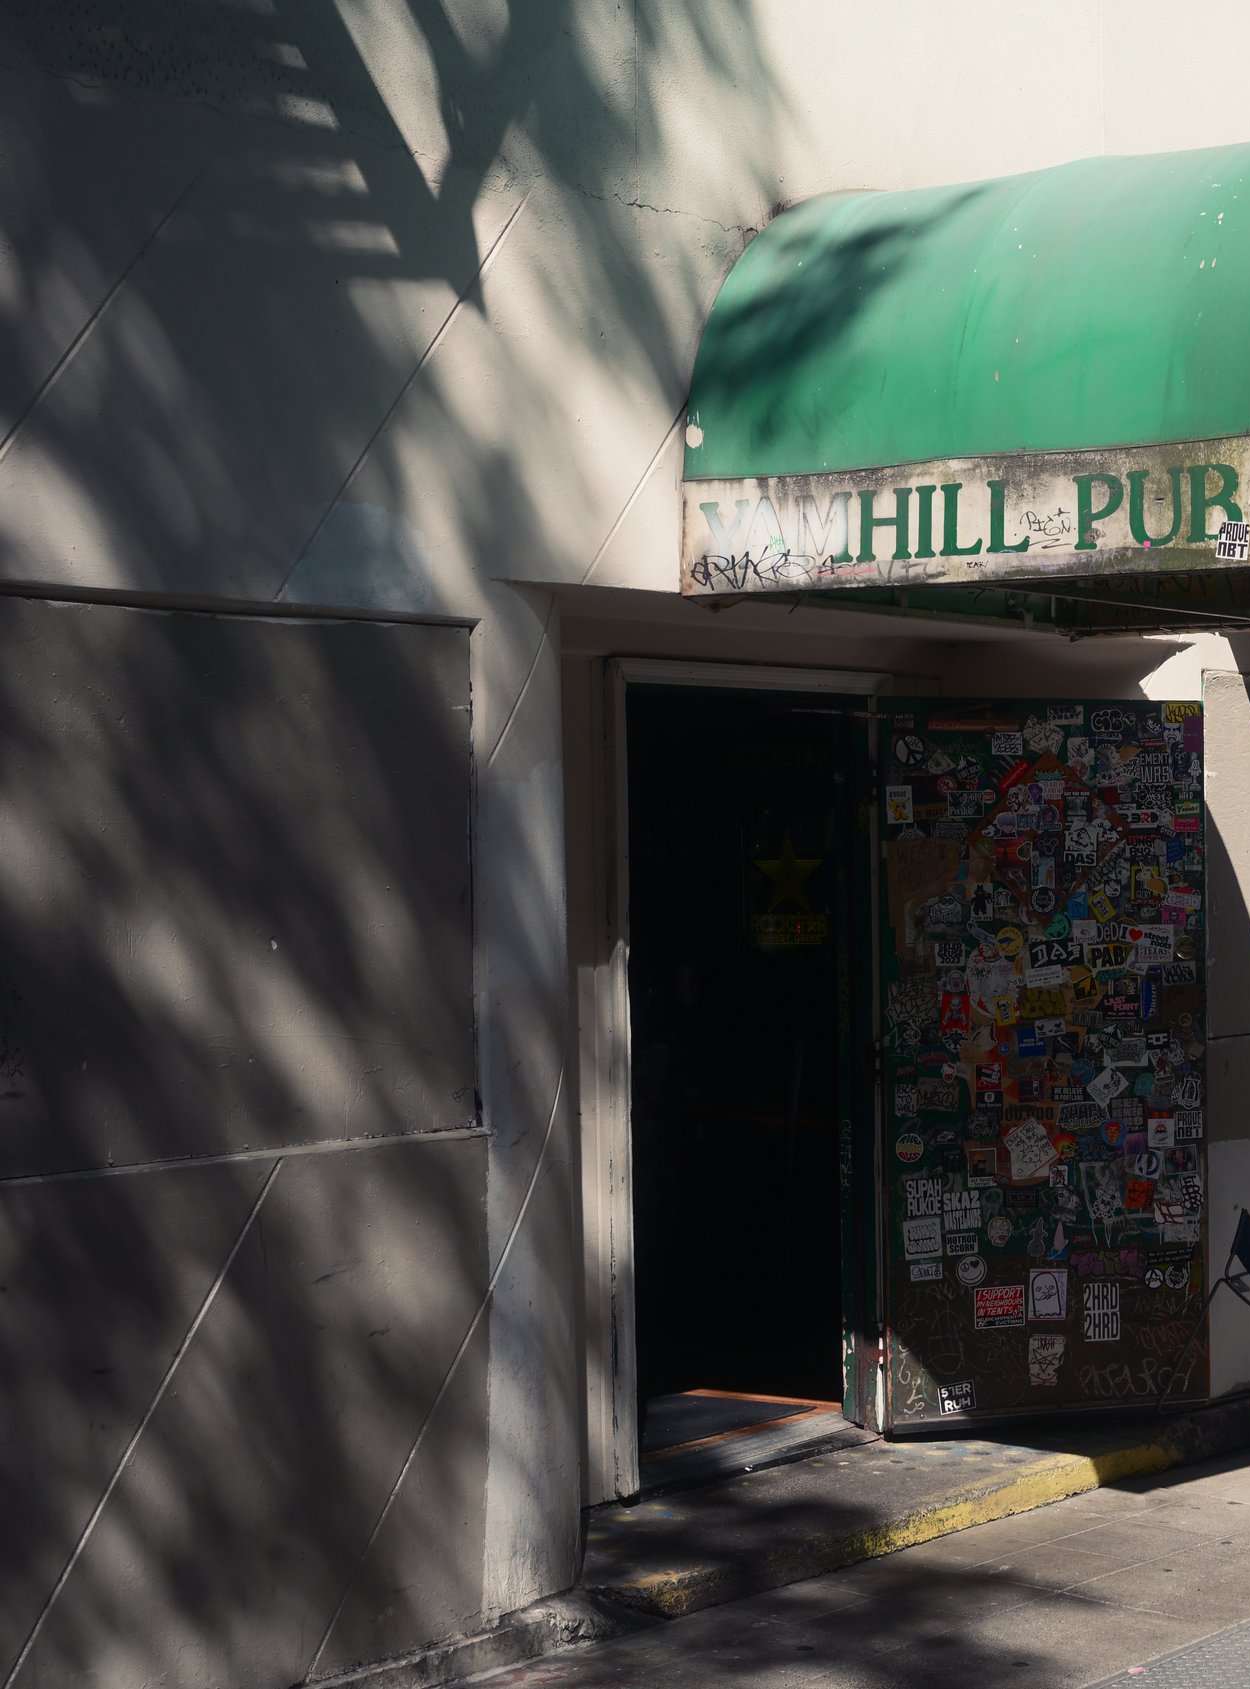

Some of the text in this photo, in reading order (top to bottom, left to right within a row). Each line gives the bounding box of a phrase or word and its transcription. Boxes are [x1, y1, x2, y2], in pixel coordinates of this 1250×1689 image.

[699, 479, 1030, 567] YAMHILL
[1073, 464, 1243, 550] PUB
[1218, 521, 1250, 544] PROVE
[1065, 851, 1095, 865] DAS
[1120, 926, 1170, 943] I street
[1143, 946, 1169, 956] TEXAS
[1150, 940, 1173, 950] roots
[1053, 1086, 1084, 1095] WE BELIEVE
[1177, 1112, 1202, 1126] PROVE
[906, 1178, 942, 1199] SUPAH
[947, 1234, 977, 1245] HOTROD
[949, 1244, 976, 1253] SCORN
[982, 1288, 1021, 1300] SUPPORT
[1084, 1283, 1120, 1312] 2HRD
[985, 1298, 1024, 1307] NEIGHBOURS
[986, 1306, 1014, 1316] TENTS
[1084, 1312, 1120, 1340] 2HRD
